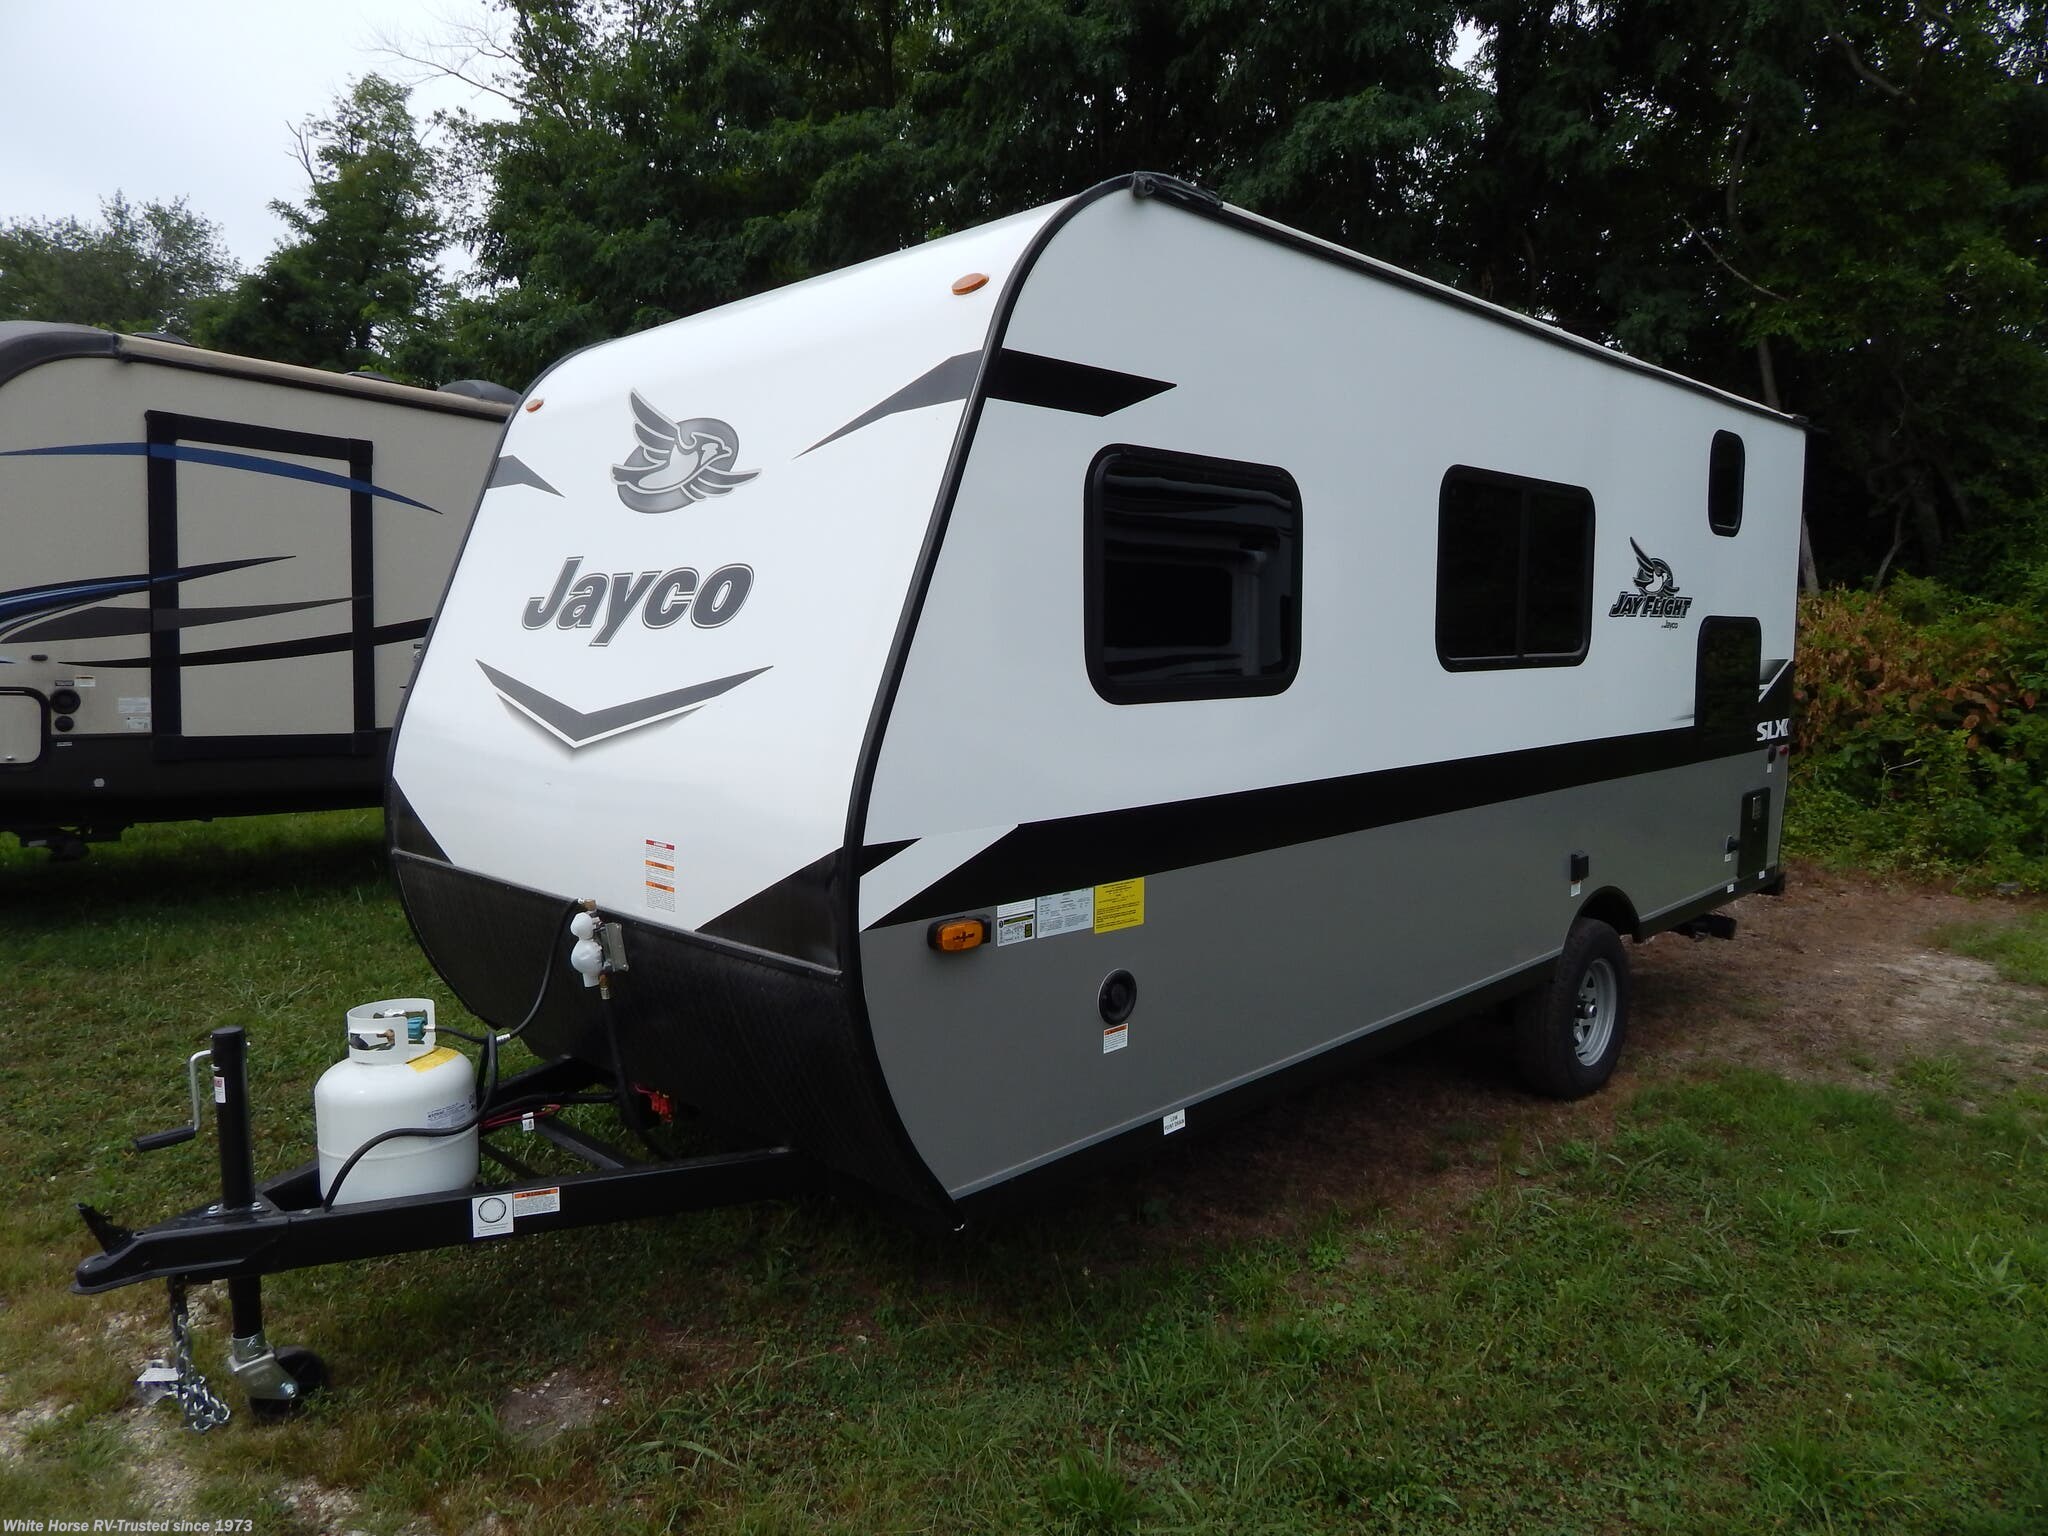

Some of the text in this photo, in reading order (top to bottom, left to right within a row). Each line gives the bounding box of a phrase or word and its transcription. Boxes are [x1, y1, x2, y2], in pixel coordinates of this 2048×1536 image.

[521, 555, 754, 647] Jayco
[1609, 592, 1693, 618] JAY FLIGHT
[1756, 717, 1790, 742] SLX
